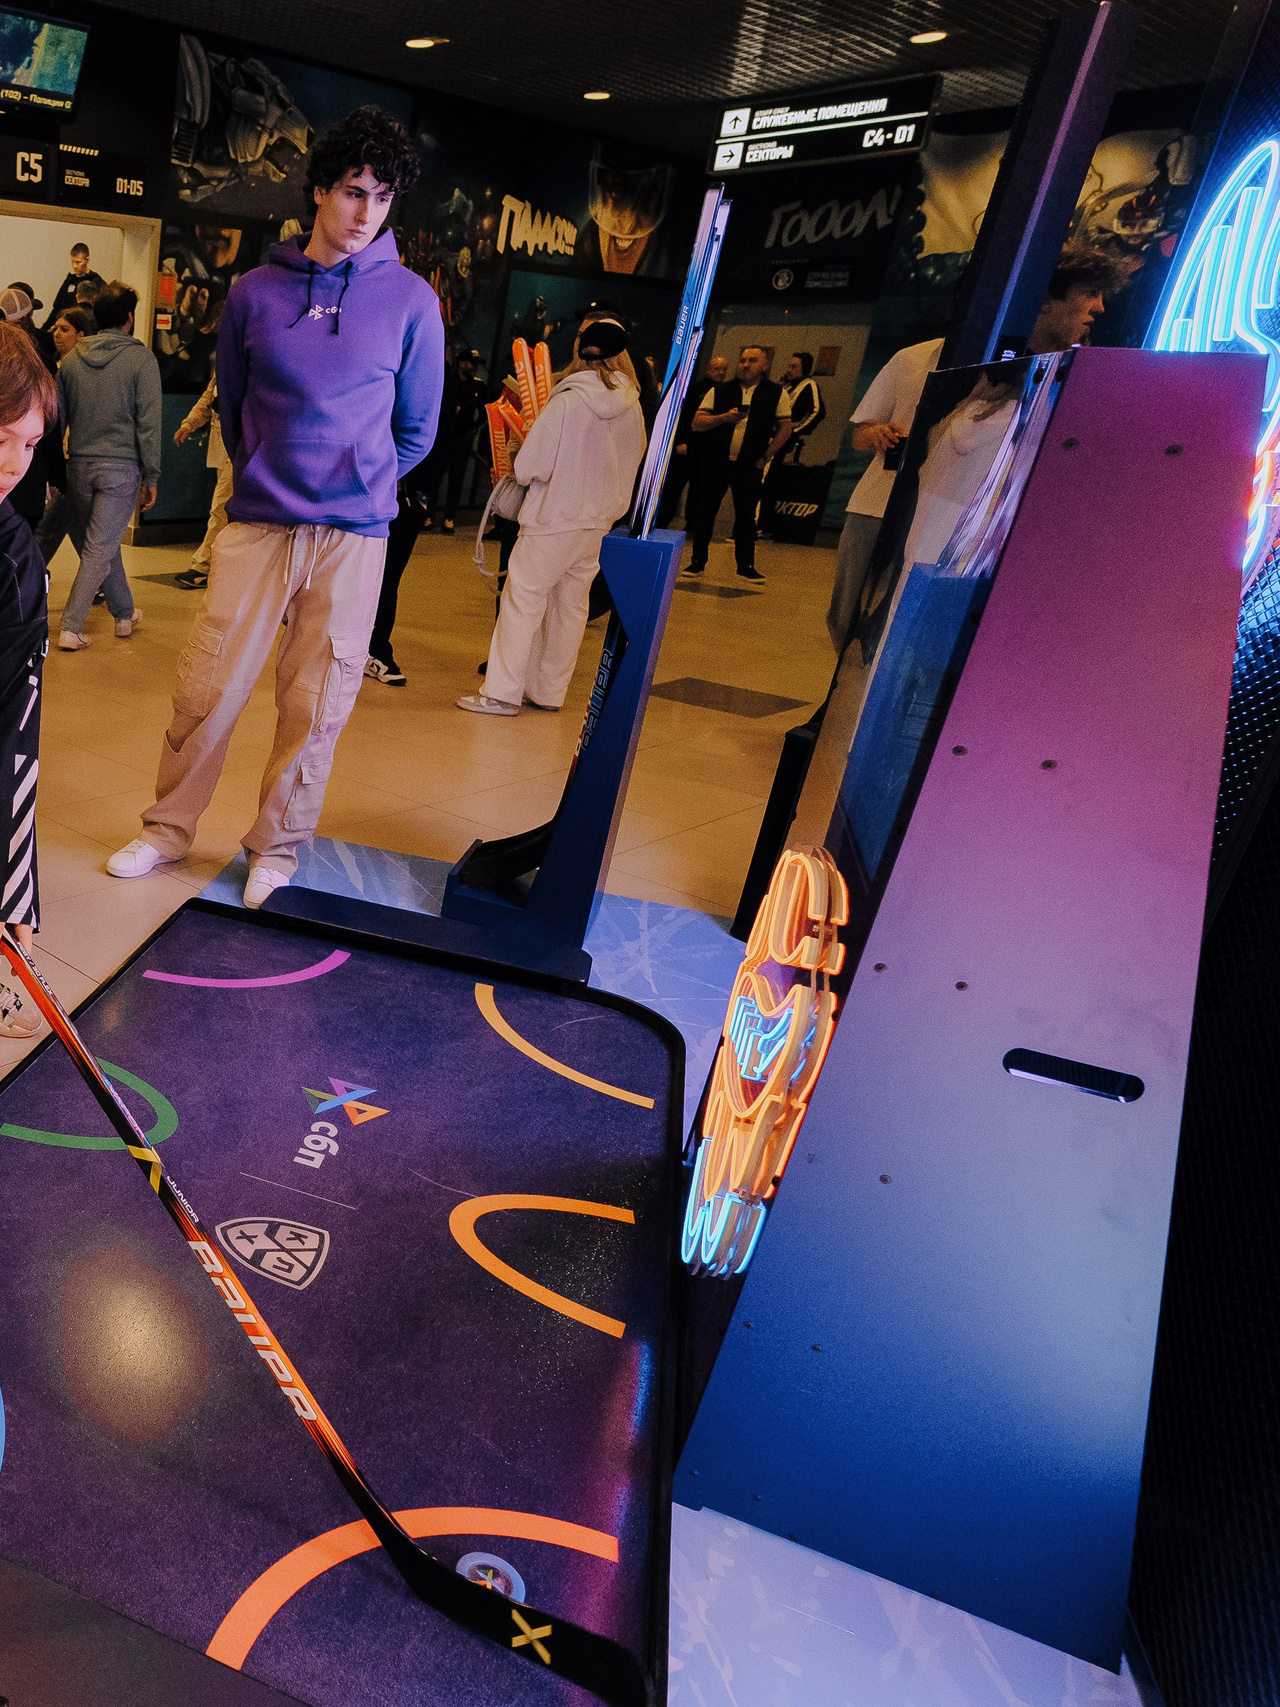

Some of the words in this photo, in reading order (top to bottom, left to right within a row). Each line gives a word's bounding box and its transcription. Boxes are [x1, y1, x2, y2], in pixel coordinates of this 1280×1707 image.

[751, 108, 818, 130] СЛУЖЕБНЫЕ
[817, 98, 888, 121] ПОМЕЩЕНИЯ
[745, 145, 795, 163] СЕКТОРЫ
[39, 975, 54, 996] FLEX
[293, 1121, 339, 1169] сбп
[166, 1175, 200, 1223] JUNIOR
